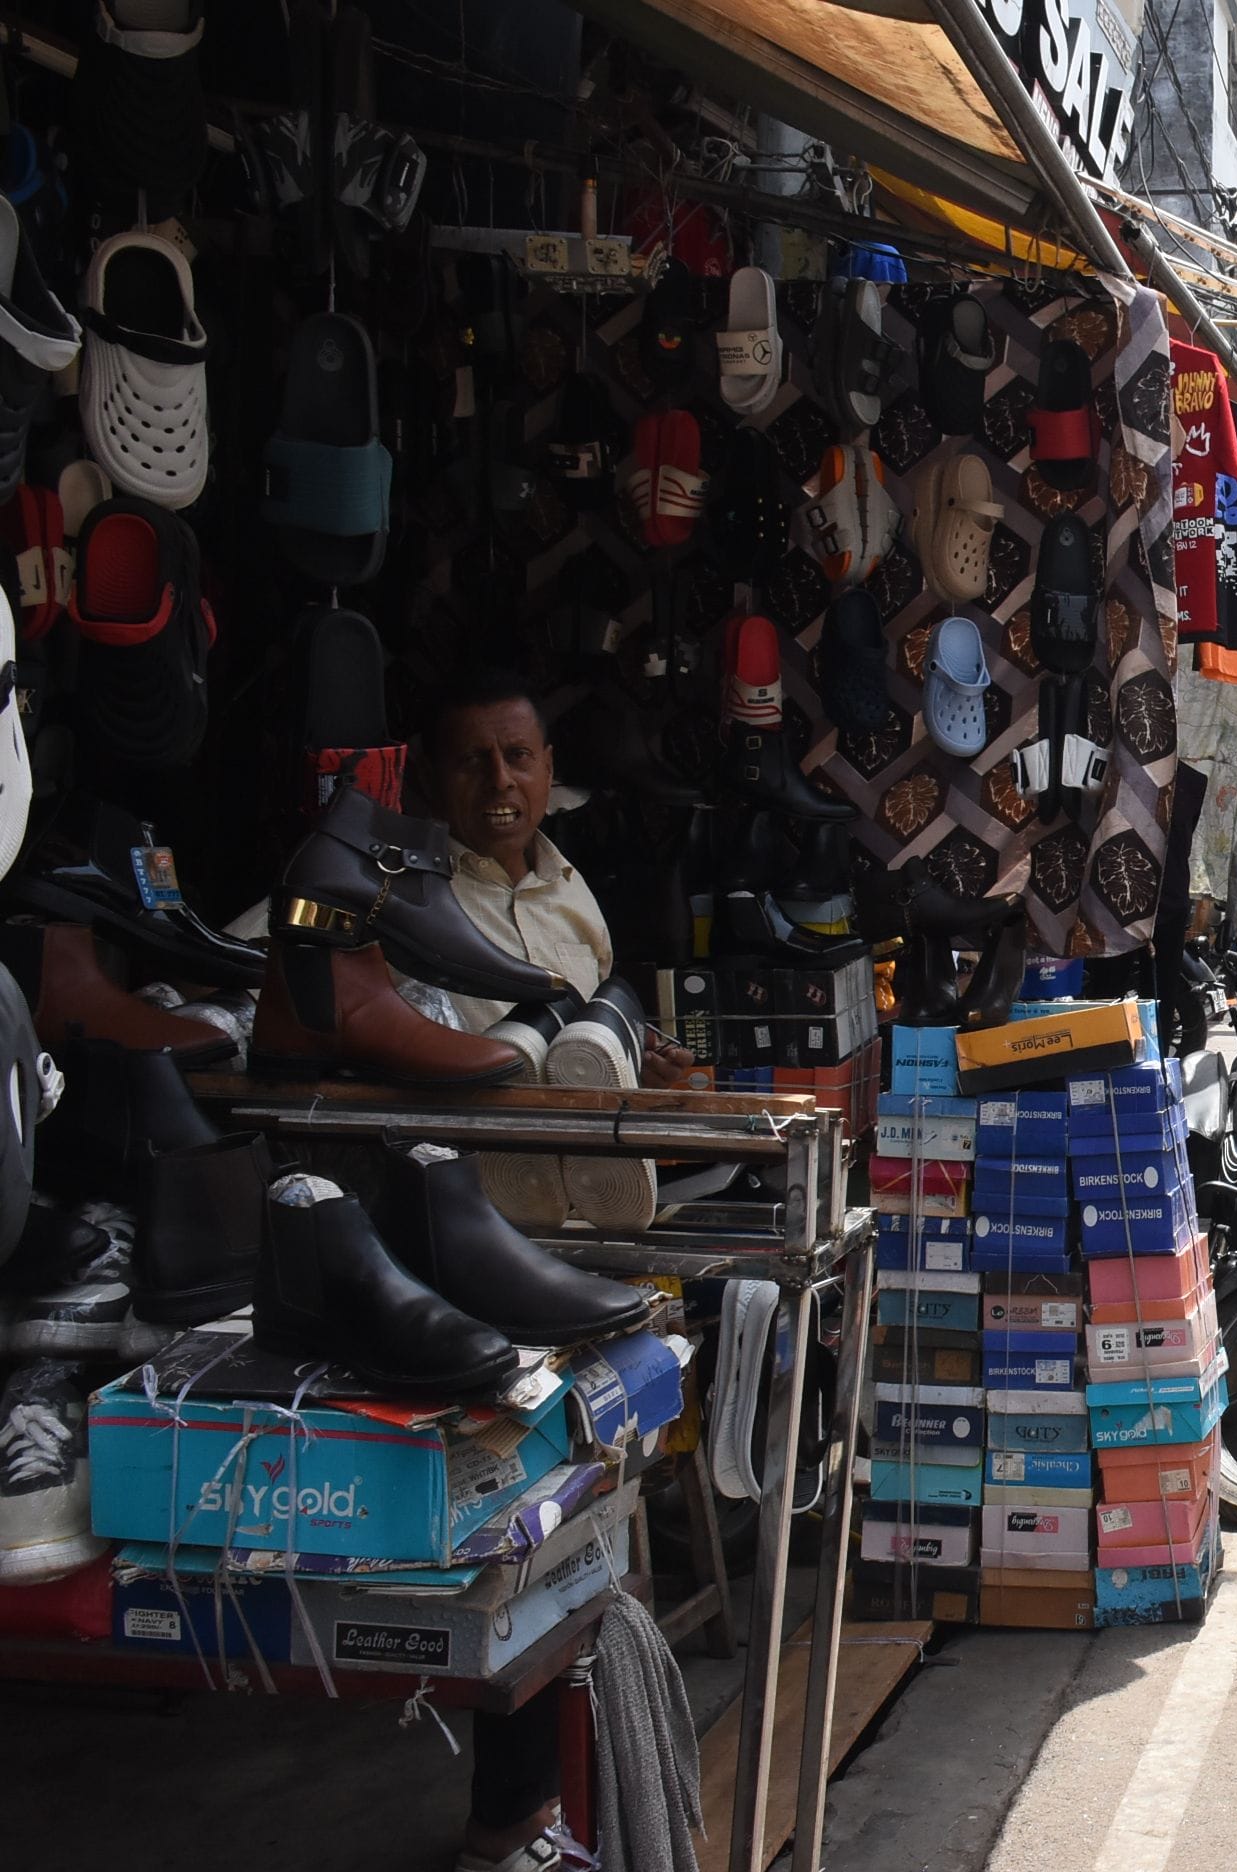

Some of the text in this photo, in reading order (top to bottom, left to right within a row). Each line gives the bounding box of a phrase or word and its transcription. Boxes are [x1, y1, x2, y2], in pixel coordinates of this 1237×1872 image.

[1039, 0, 1135, 188] SALE
[1176, 370, 1217, 394] JOHNNY
[1175, 391, 1214, 415] BRAVO
[1174, 517, 1214, 530] RTOON
[1174, 526, 1215, 540] TWORK
[1104, 1086, 1151, 1096] BIRKENSTO
[1079, 1172, 1144, 1186] BIRKENSTOCK
[1098, 1208, 1163, 1221] BIRKENSTOCK
[990, 1222, 1054, 1237] BIRKENSTOCK
[988, 1367, 1036, 1376] BIRKENSTOCK
[342, 1628, 401, 1649] Leather
